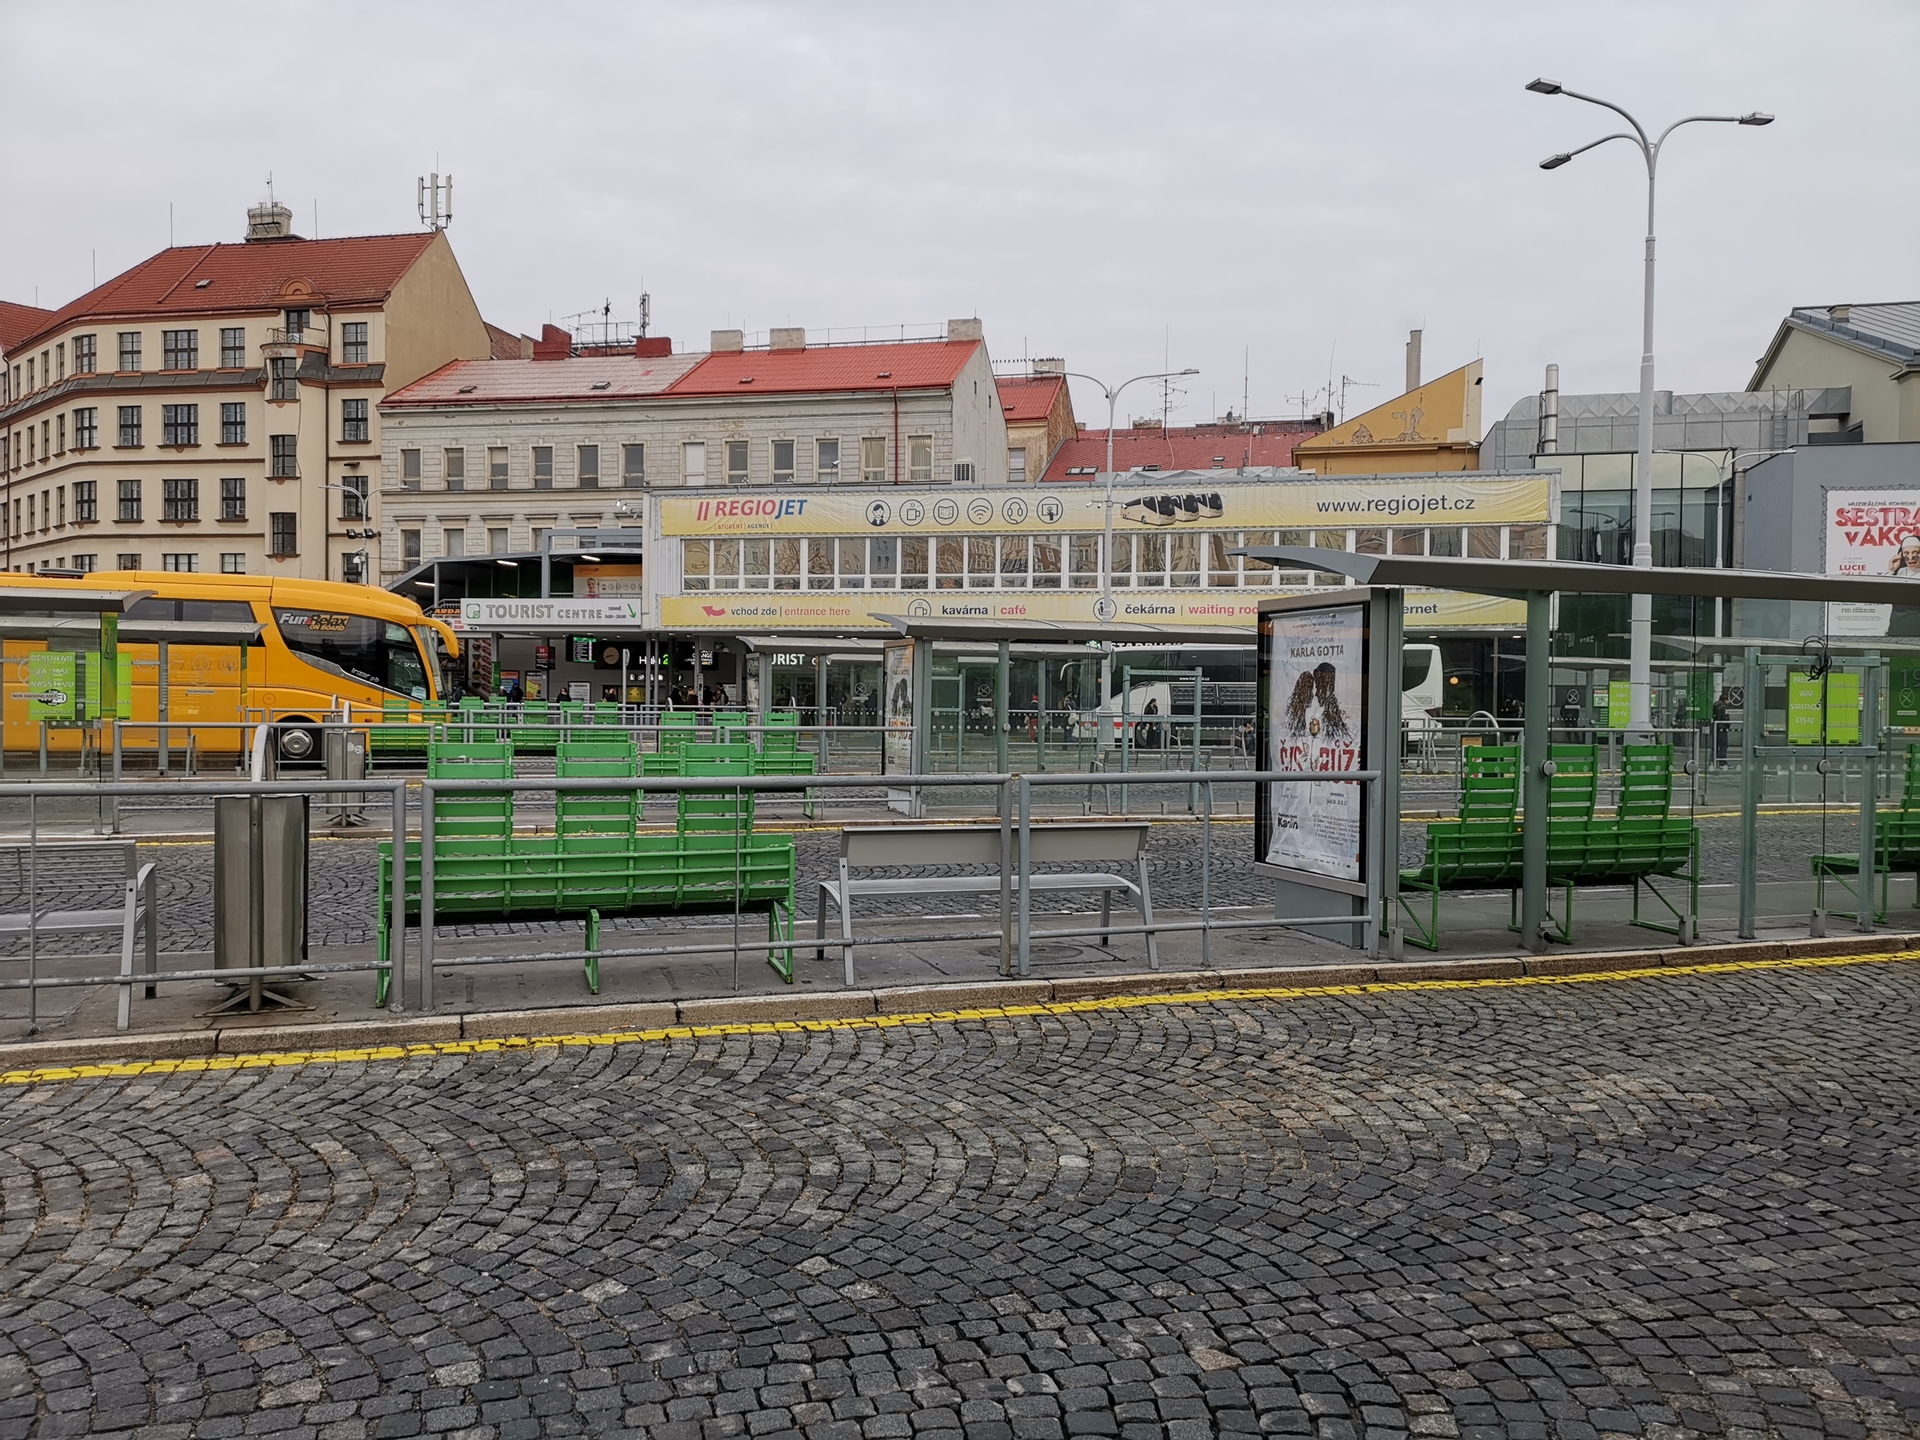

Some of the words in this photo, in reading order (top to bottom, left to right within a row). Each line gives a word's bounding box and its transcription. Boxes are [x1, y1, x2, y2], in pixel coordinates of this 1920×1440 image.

[714, 499, 808, 520] REGIOJET
[1317, 494, 1476, 516] www.regiojet.cz
[717, 522, 744, 530] STUDENT
[486, 604, 554, 619] TOURIST
[557, 609, 602, 619] CENTRE
[730, 606, 759, 617] vchod
[761, 606, 777, 617] zde
[784, 607, 826, 617] entrance
[829, 606, 851, 617] here
[942, 605, 989, 615] kavárna
[1000, 605, 1027, 615] café
[1125, 604, 1175, 614] čekárna
[1188, 604, 1235, 617] waiting
[1239, 606, 1259, 615] roo
[1403, 603, 1438, 614] ernet
[1290, 646, 1316, 658] KARLA
[1317, 644, 1344, 656] GOTTA
[662, 653, 669, 665] 2
